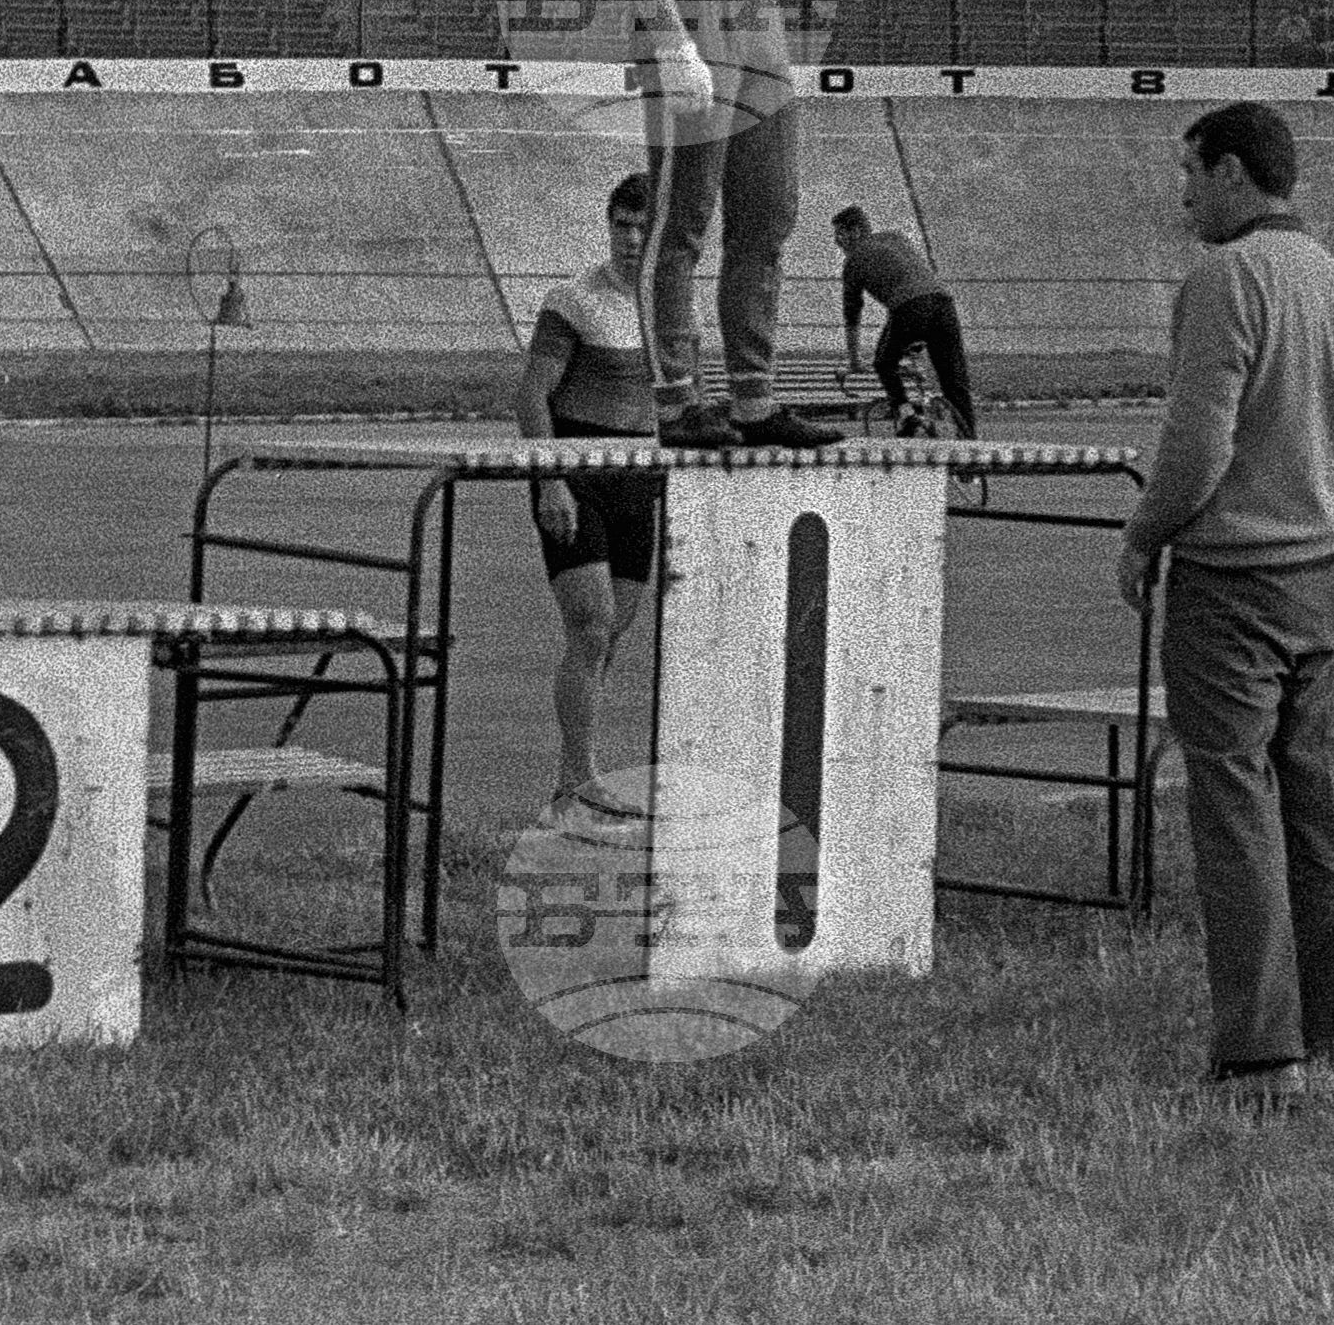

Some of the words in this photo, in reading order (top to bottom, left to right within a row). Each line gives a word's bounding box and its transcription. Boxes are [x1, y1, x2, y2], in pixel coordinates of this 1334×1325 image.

[819, 68, 977, 95] ОТ
[1131, 69, 1166, 96] 8
[774, 511, 830, 954] 1
